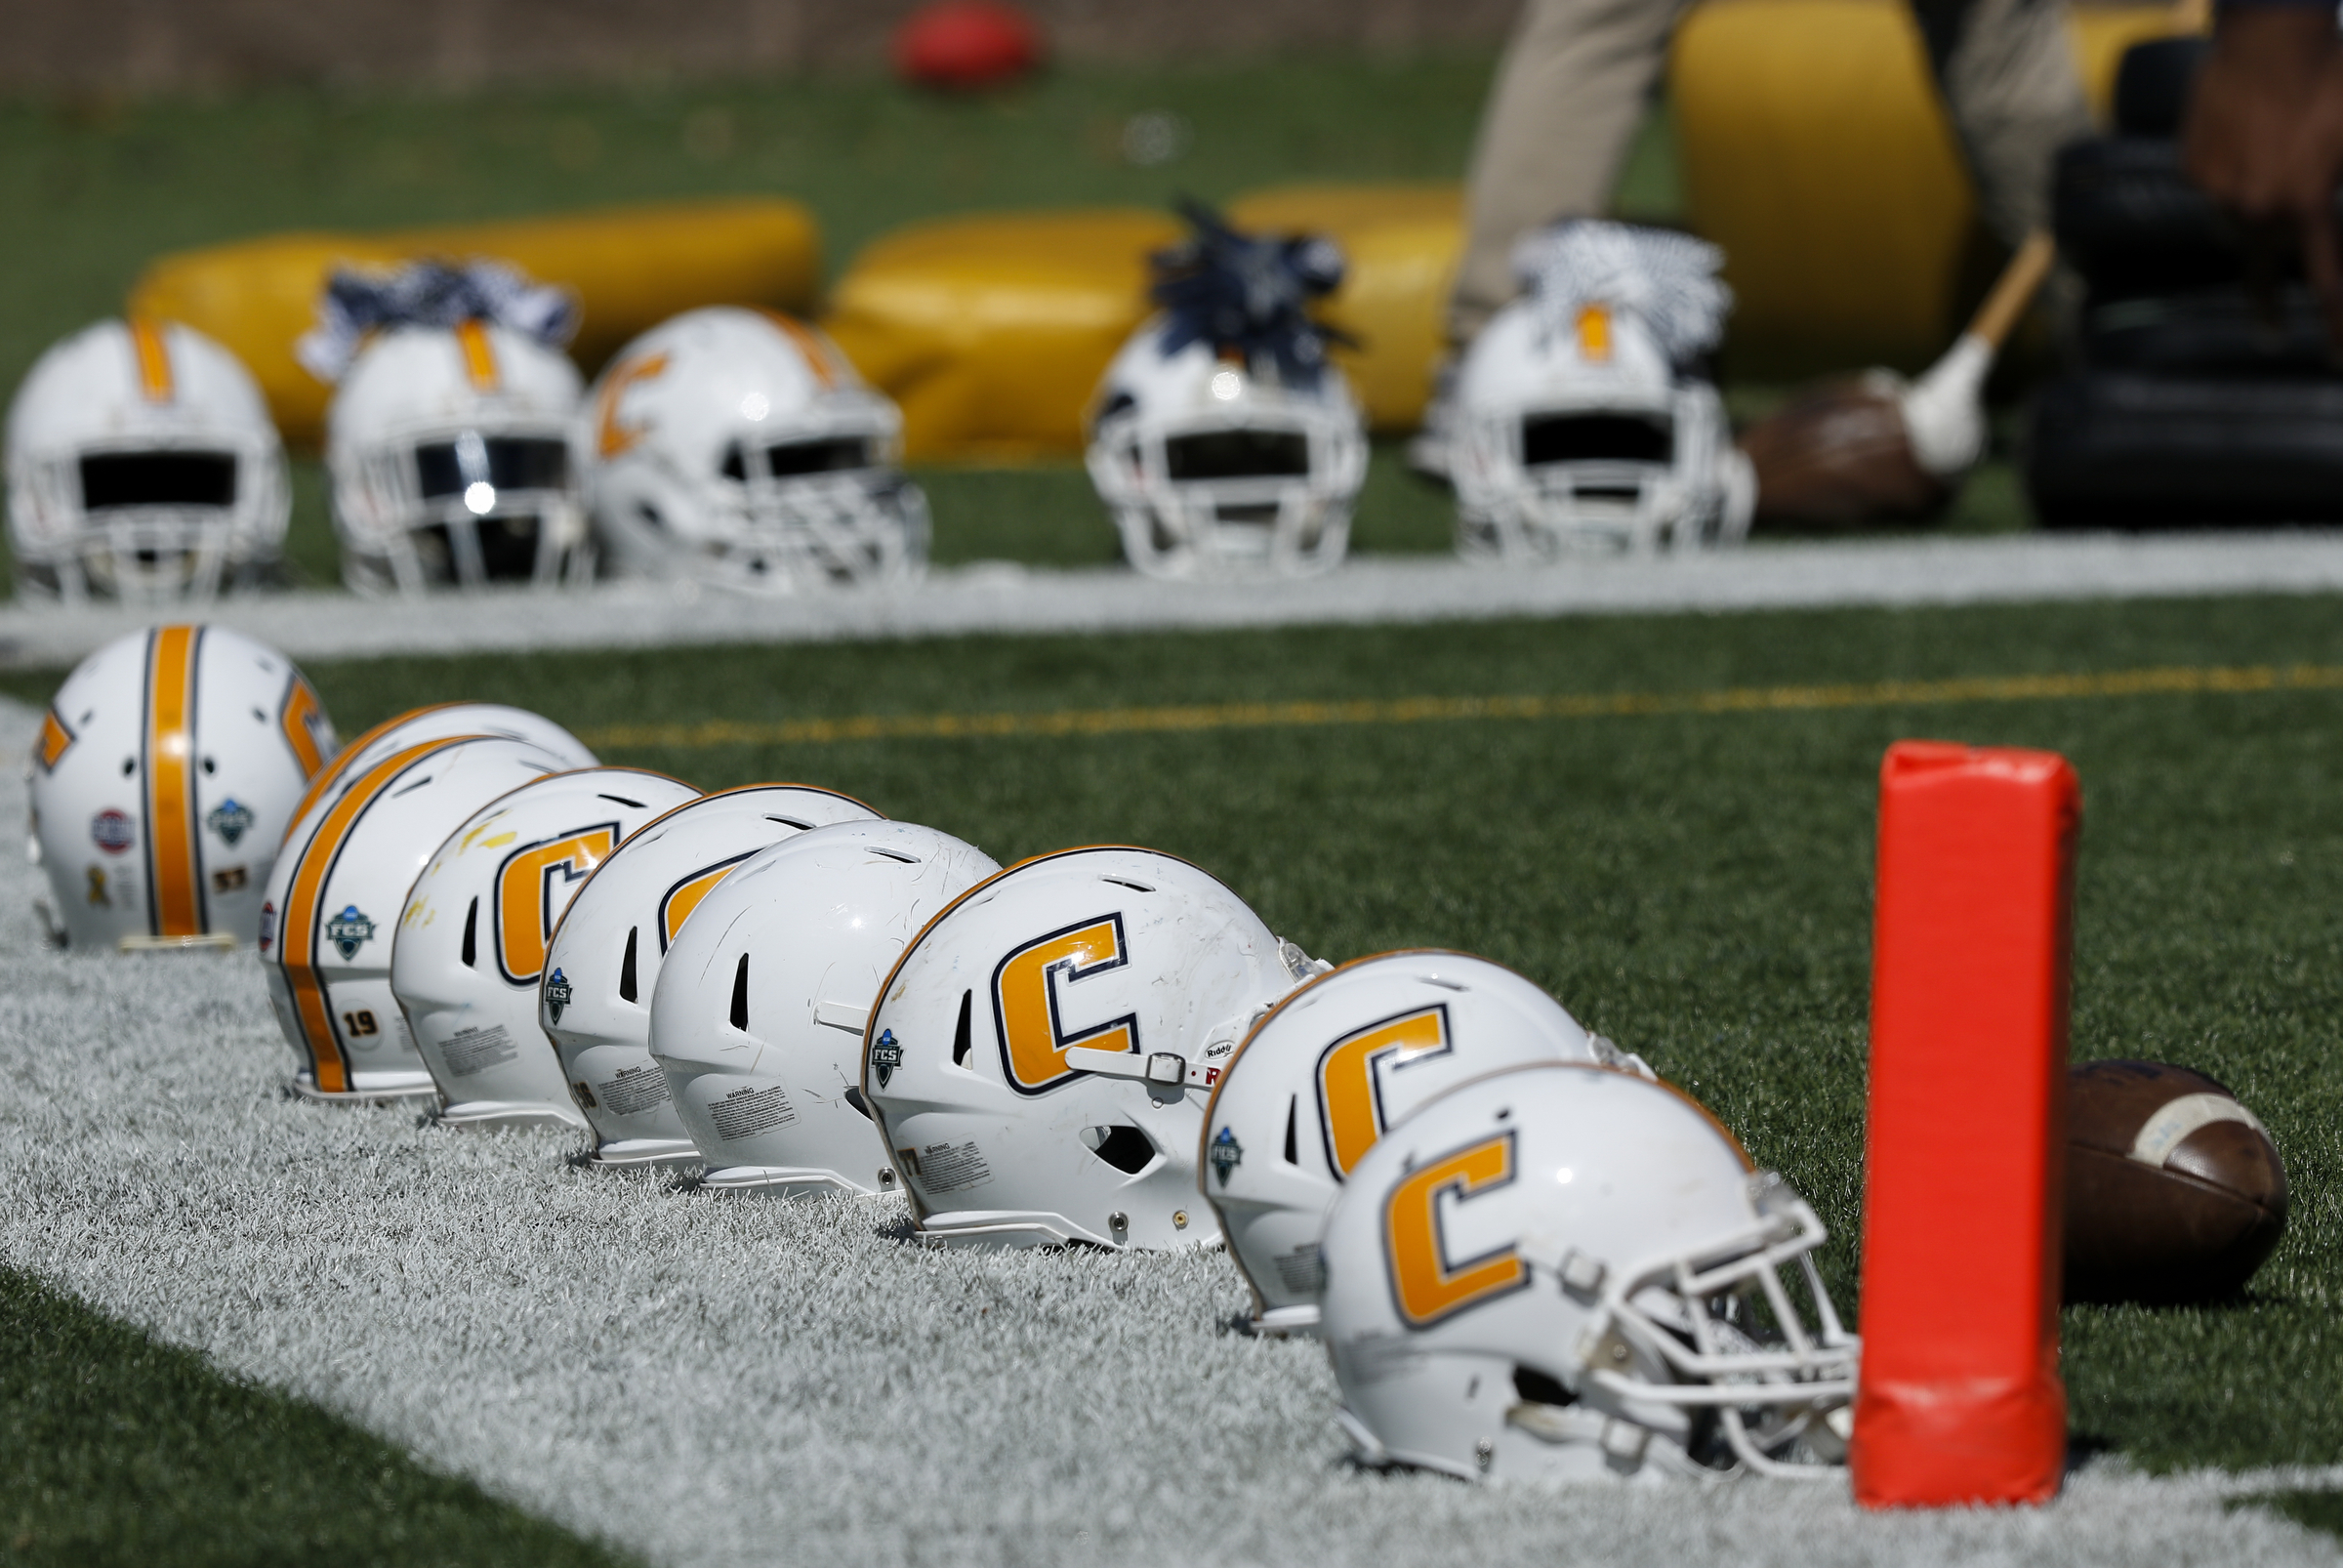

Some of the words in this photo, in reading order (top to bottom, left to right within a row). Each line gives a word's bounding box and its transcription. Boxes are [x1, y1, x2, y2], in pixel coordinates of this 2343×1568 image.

[494, 821, 620, 986] C
[548, 986, 567, 999] FCS
[991, 911, 1141, 1095] C
[343, 1010, 378, 1038] 19
[874, 1049, 897, 1061] FCS
[725, 1087, 755, 1099] WARNING
[1315, 1003, 1453, 1185] C
[896, 1146, 923, 1177] 77
[1381, 1128, 1533, 1331] C
